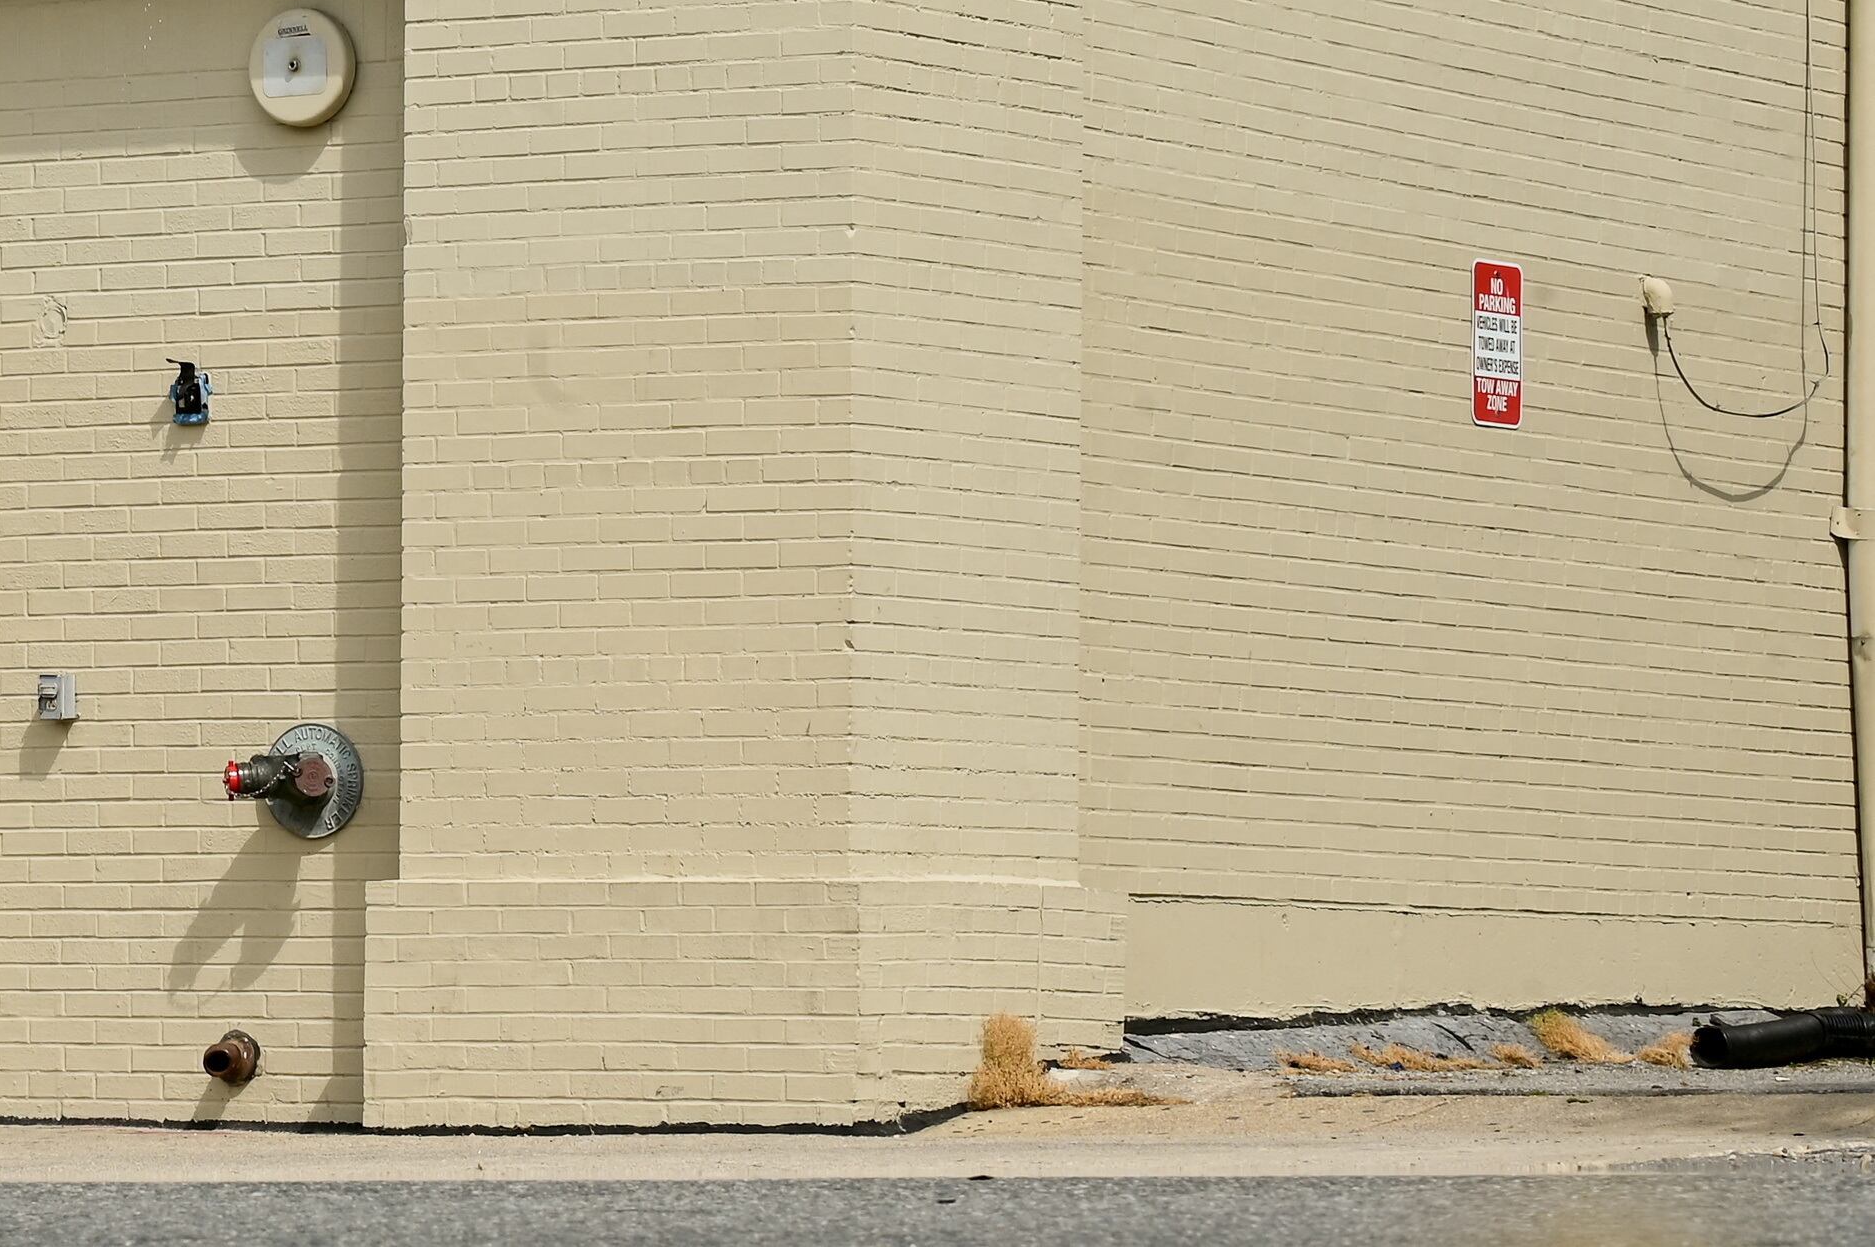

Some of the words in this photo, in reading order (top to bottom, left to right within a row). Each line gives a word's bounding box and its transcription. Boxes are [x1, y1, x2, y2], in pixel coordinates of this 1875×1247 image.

[1490, 277, 1503, 295] NO
[1478, 293, 1516, 314] PARKING
[1476, 377, 1495, 393] TOW
[1496, 380, 1518, 397] AWAY
[1486, 395, 1507, 412] ZONE
[294, 726, 351, 760] AUTOMATIC
[325, 763, 357, 831] SPRINKLER
